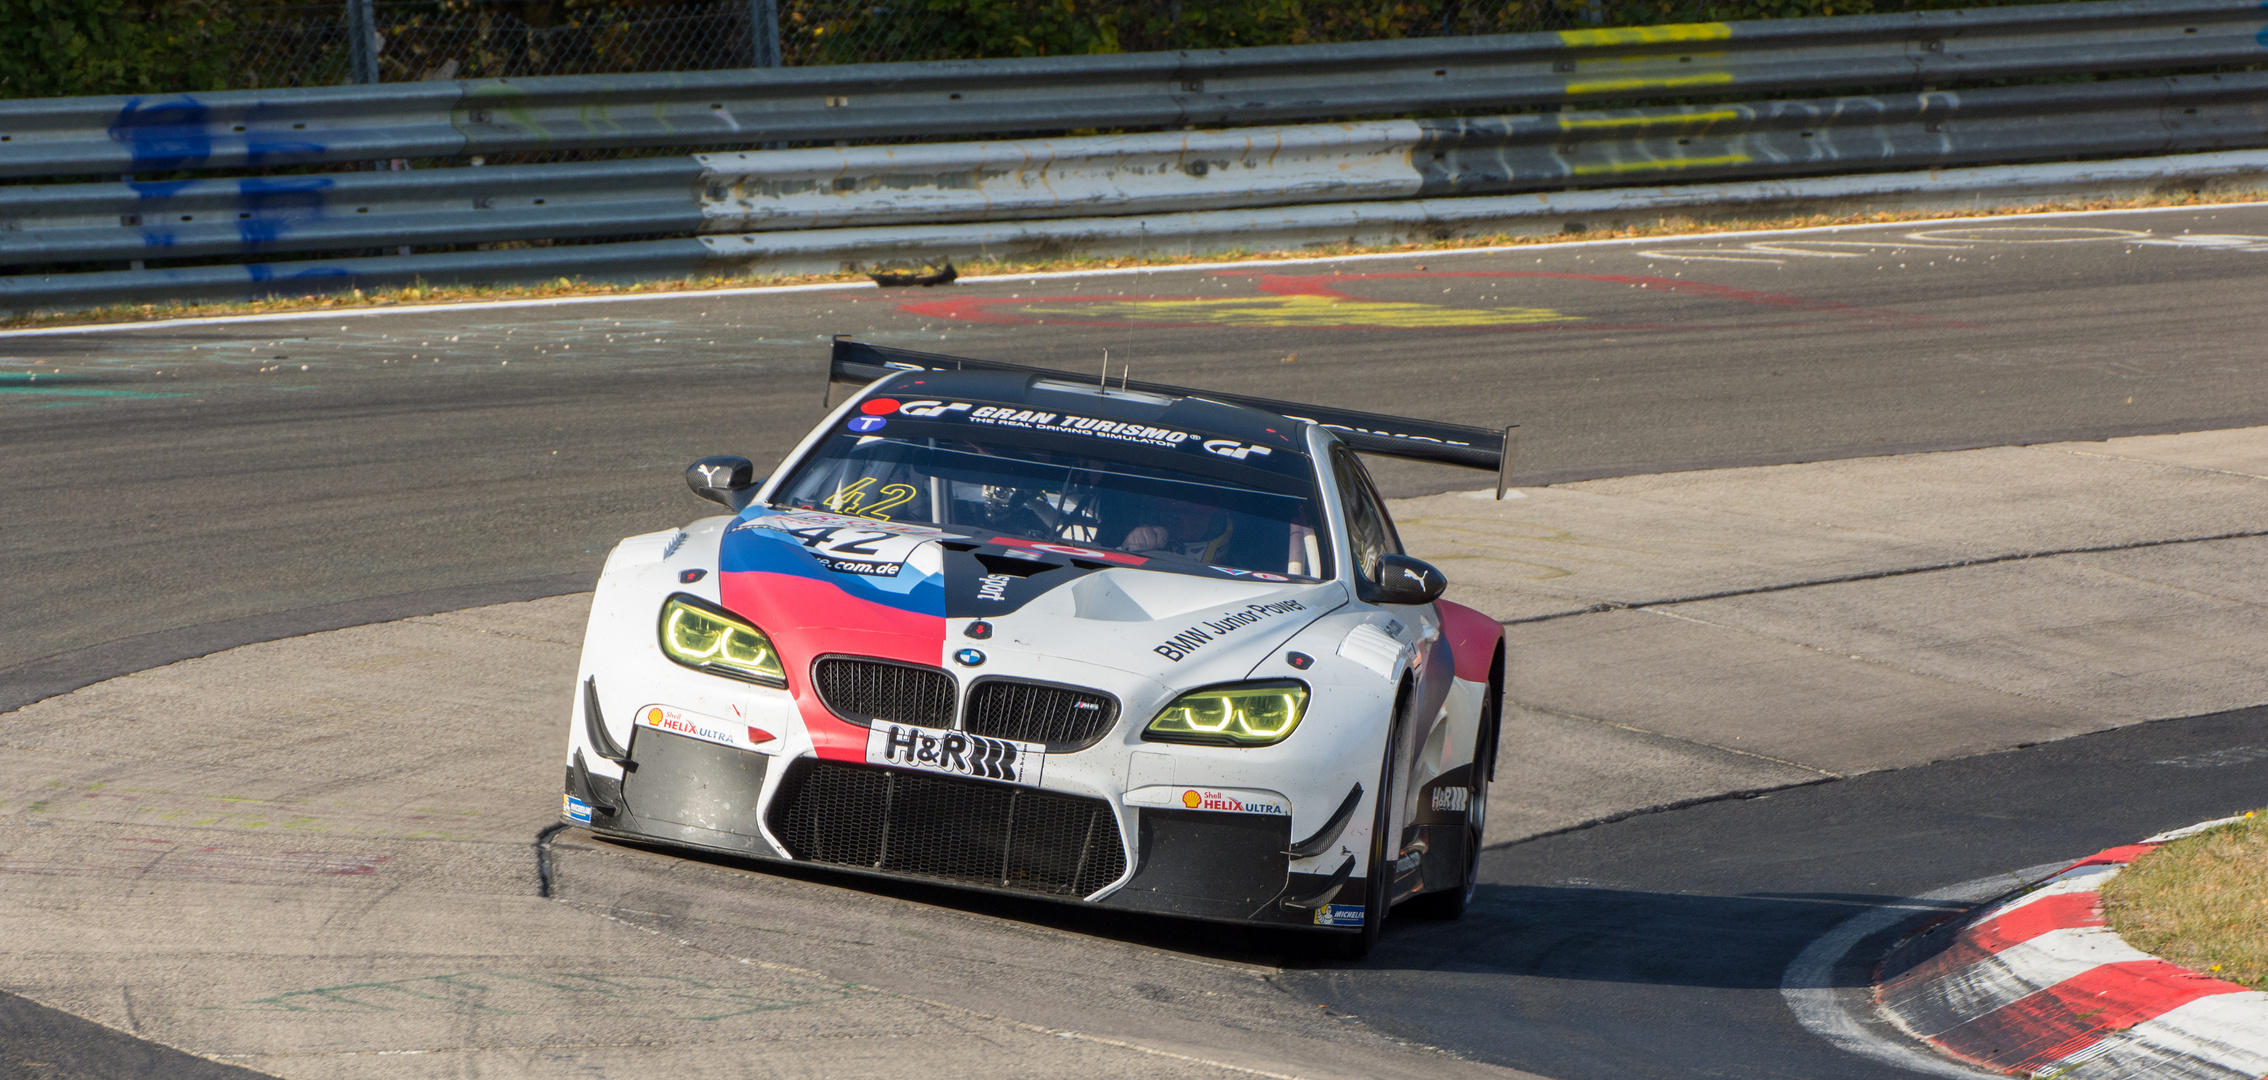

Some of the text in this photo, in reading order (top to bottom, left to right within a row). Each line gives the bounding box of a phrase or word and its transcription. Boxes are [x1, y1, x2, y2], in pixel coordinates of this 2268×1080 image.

[860, 417, 881, 430] T
[972, 406, 1057, 424] GRAN
[969, 416, 1177, 448] THE REAL DRIVING SIMULATOR
[823, 476, 917, 522] 42
[792, 526, 900, 556] 42
[1153, 599, 1307, 662] BMW Junior Power
[666, 710, 682, 720] Shell
[663, 718, 734, 744] HELIX ULTRA
[885, 725, 970, 773] H&R
[1204, 791, 1222, 799] Shell
[1204, 798, 1282, 813] HELIX ULTRA
